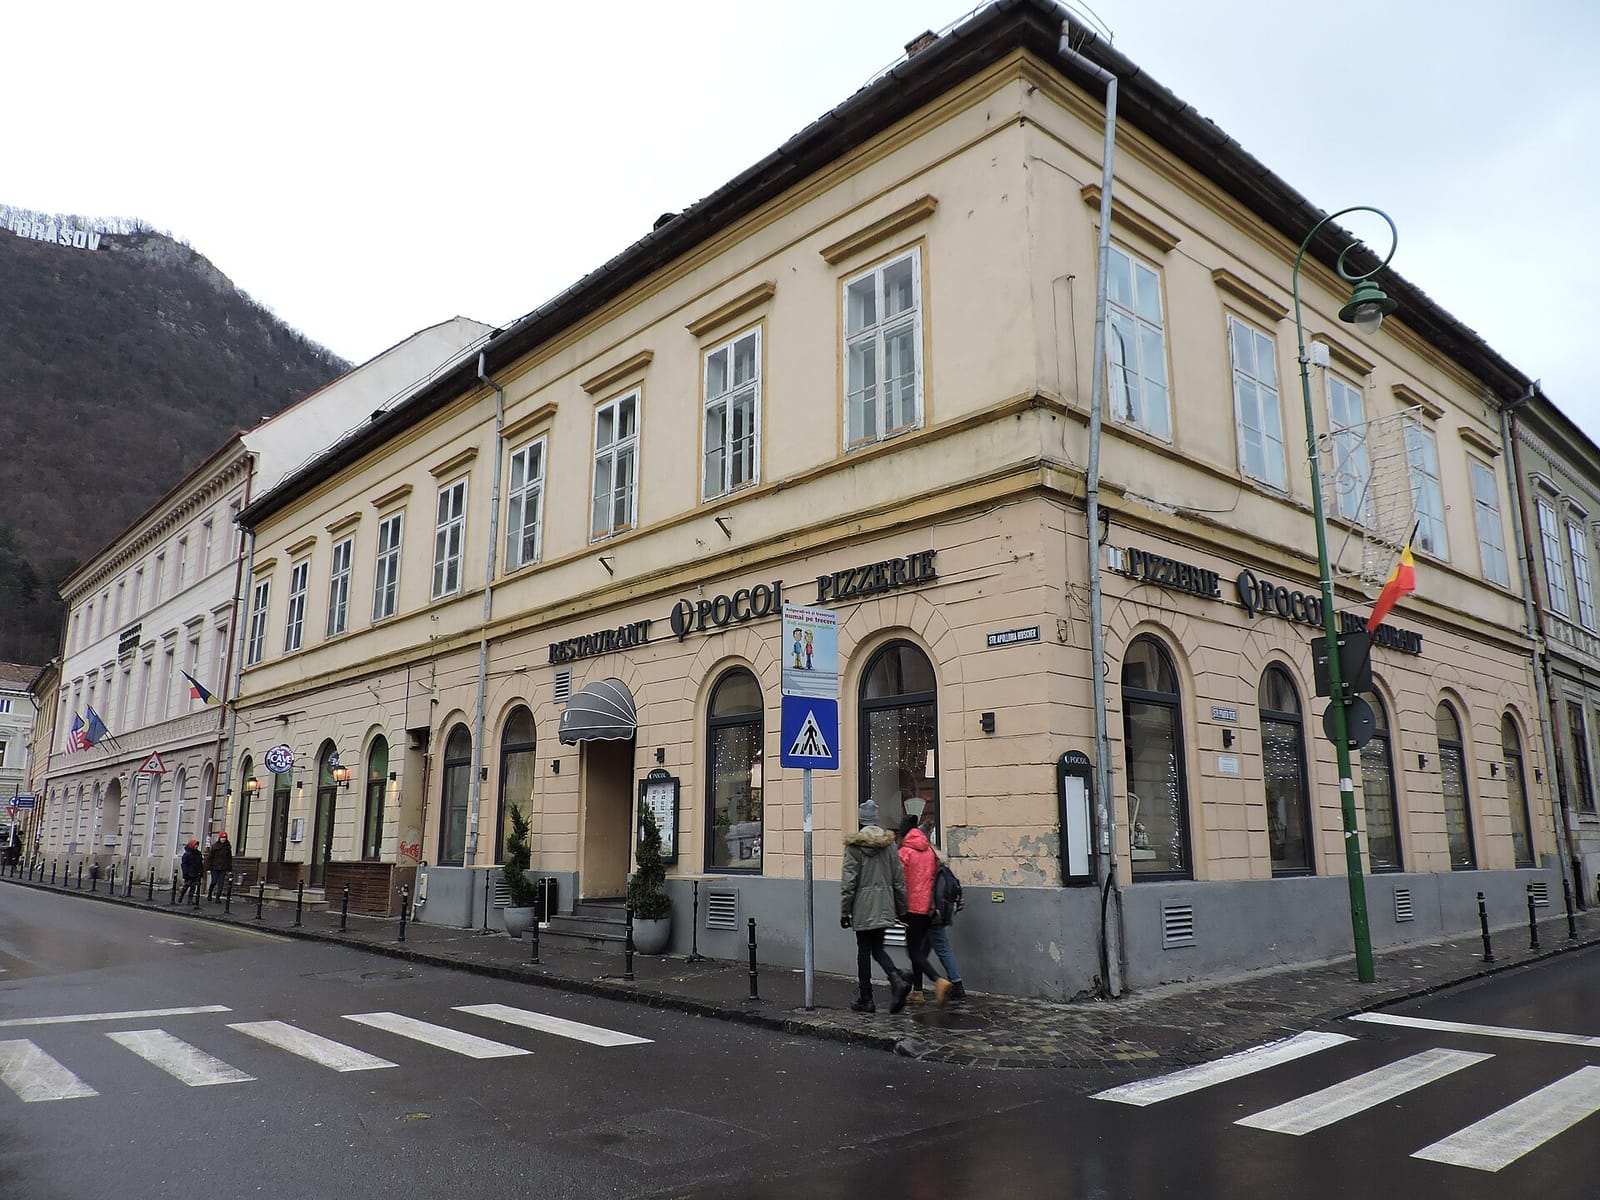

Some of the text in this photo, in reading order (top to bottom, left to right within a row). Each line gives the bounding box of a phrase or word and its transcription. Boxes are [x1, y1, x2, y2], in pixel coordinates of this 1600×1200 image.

[548, 619, 652, 663] RESTAURANT
[816, 549, 938, 602] PIZZERIE
[1128, 547, 1222, 598] PIZZERIE
[1260, 579, 1324, 626] POCO
[784, 613, 804, 621] numai
[815, 616, 837, 625] trecere
[270, 755, 292, 764] CAVE
